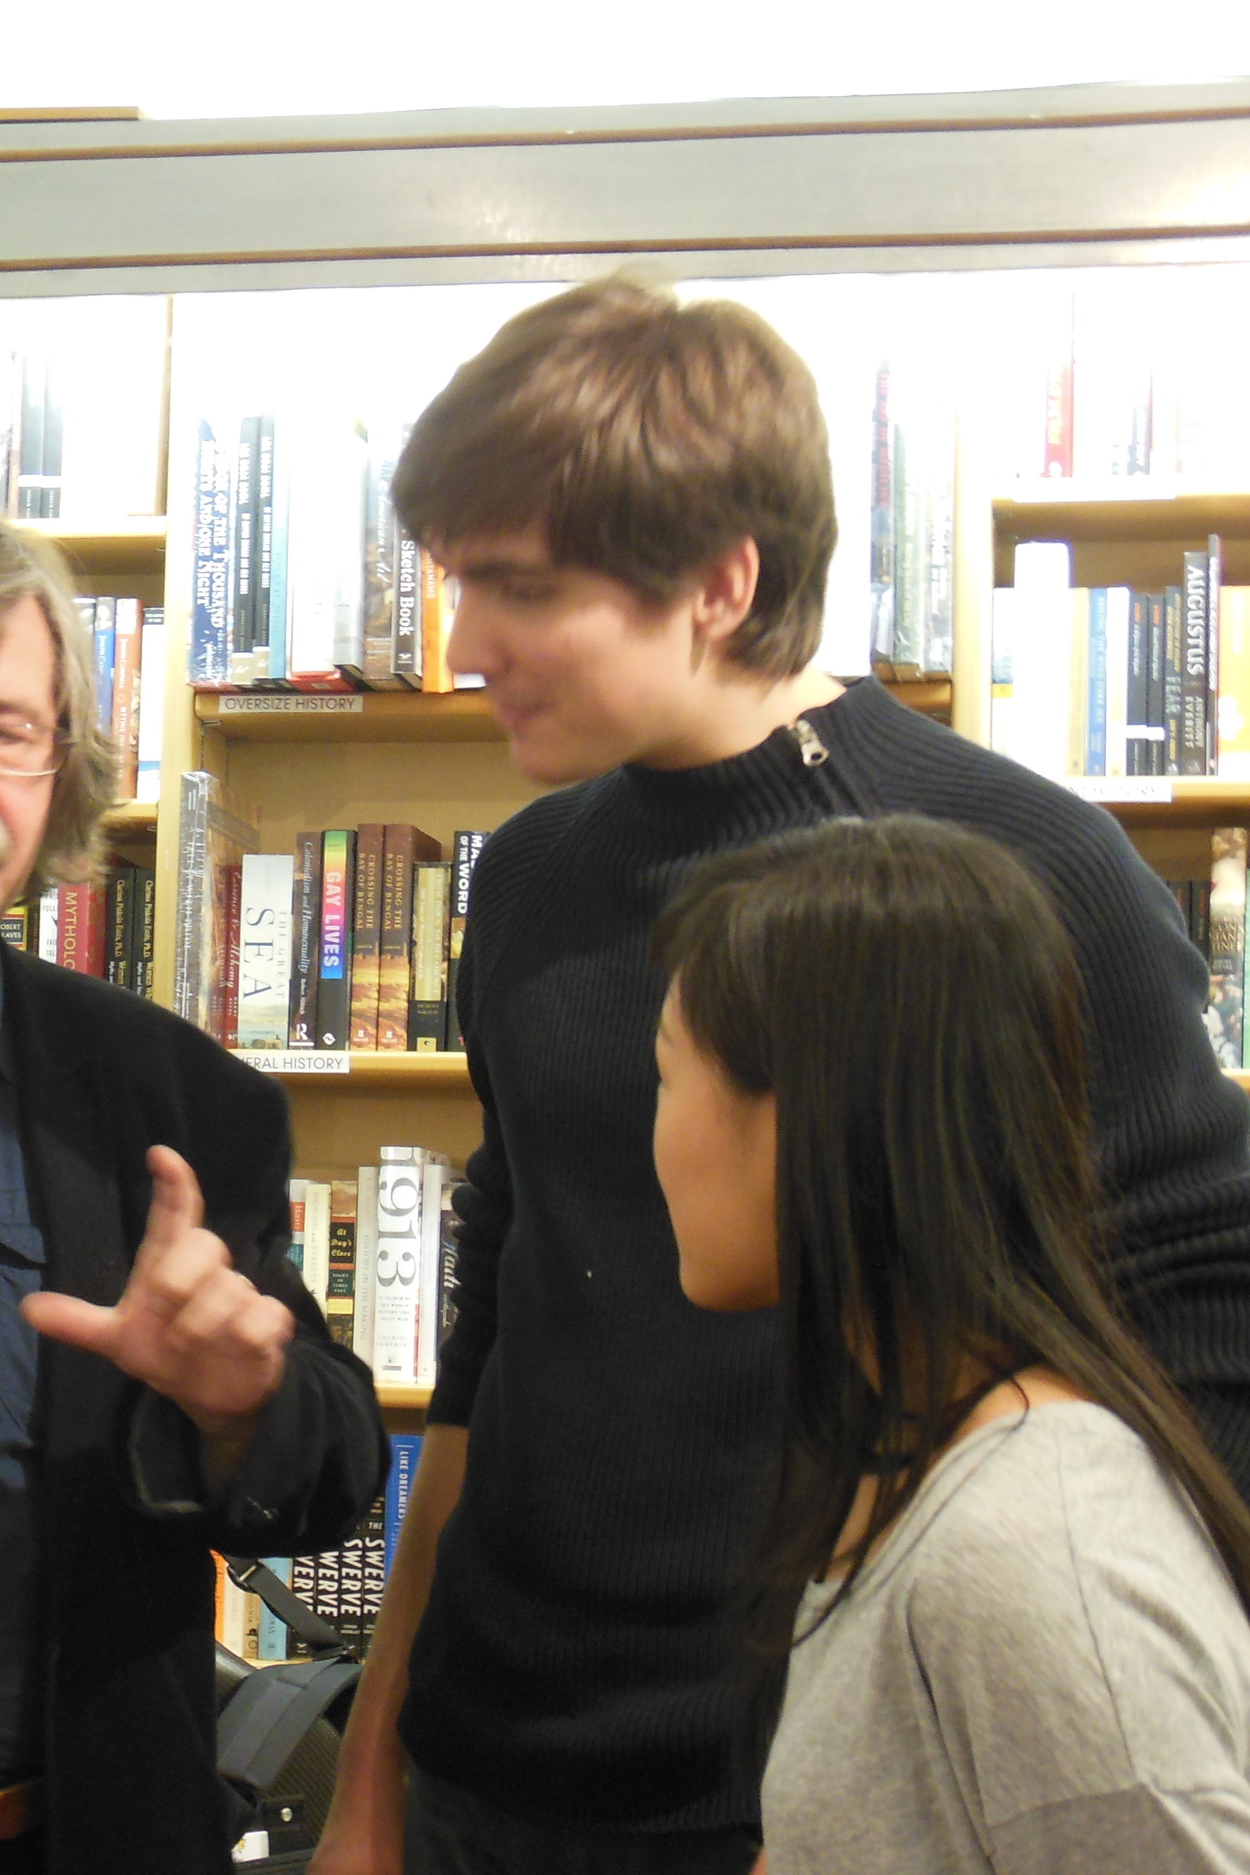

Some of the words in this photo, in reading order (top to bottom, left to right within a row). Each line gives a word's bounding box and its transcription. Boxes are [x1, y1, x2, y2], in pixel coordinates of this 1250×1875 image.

[212, 517, 228, 546] THE
[196, 561, 212, 606] NIGHT
[401, 539, 416, 593] Sketch
[211, 549, 229, 628] THOUSAND
[399, 598, 416, 636] Book
[1186, 565, 1206, 676] AUGUSTUS
[224, 697, 291, 710] OVERSIZE
[295, 697, 355, 710] HISTORY
[1165, 676, 1181, 714] FEAR
[1185, 696, 1195, 748] EVERITT
[459, 835, 469, 847] OF
[459, 847, 468, 861] THE
[303, 841, 313, 894] Colonialism
[357, 874, 365, 885] OF
[358, 853, 366, 871] BAY
[367, 854, 375, 905] CROSSING
[385, 875, 393, 887] OF
[386, 853, 394, 871] BAY
[395, 854, 404, 906] CROSSING
[325, 871, 342, 907] GAY
[457, 863, 470, 914] WORD
[63, 891, 78, 969] MYTHOLO
[278, 911, 287, 936] THE
[356, 891, 364, 931] BENGAL
[366, 909, 374, 929] THE
[384, 892, 392, 931] BENGAL
[393, 910, 402, 930] THE
[1, 931, 22, 940] RAVES
[244, 907, 275, 998] SEA
[298, 910, 312, 974] Homosexuality
[323, 914, 341, 967] LIVES
[227, 932, 240, 988] Alchemy
[276, 948, 286, 998] GREAT
[242, 1057, 278, 1070] ERAL
[283, 1057, 343, 1070] HISTORY
[311, 1193, 319, 1231] DANCING
[377, 1147, 419, 1287] 1913
[310, 1245, 318, 1283] STREETS
[363, 1235, 371, 1269] HISTORY
[362, 1272, 370, 1284] IN
[360, 1305, 368, 1341] MAKING
[399, 1451, 409, 1470] LIKE
[368, 1522, 383, 1530] THE
[317, 1551, 340, 1617] WERVE
[340, 1538, 362, 1617] SWERVE
[363, 1537, 385, 1615] SWERVE
